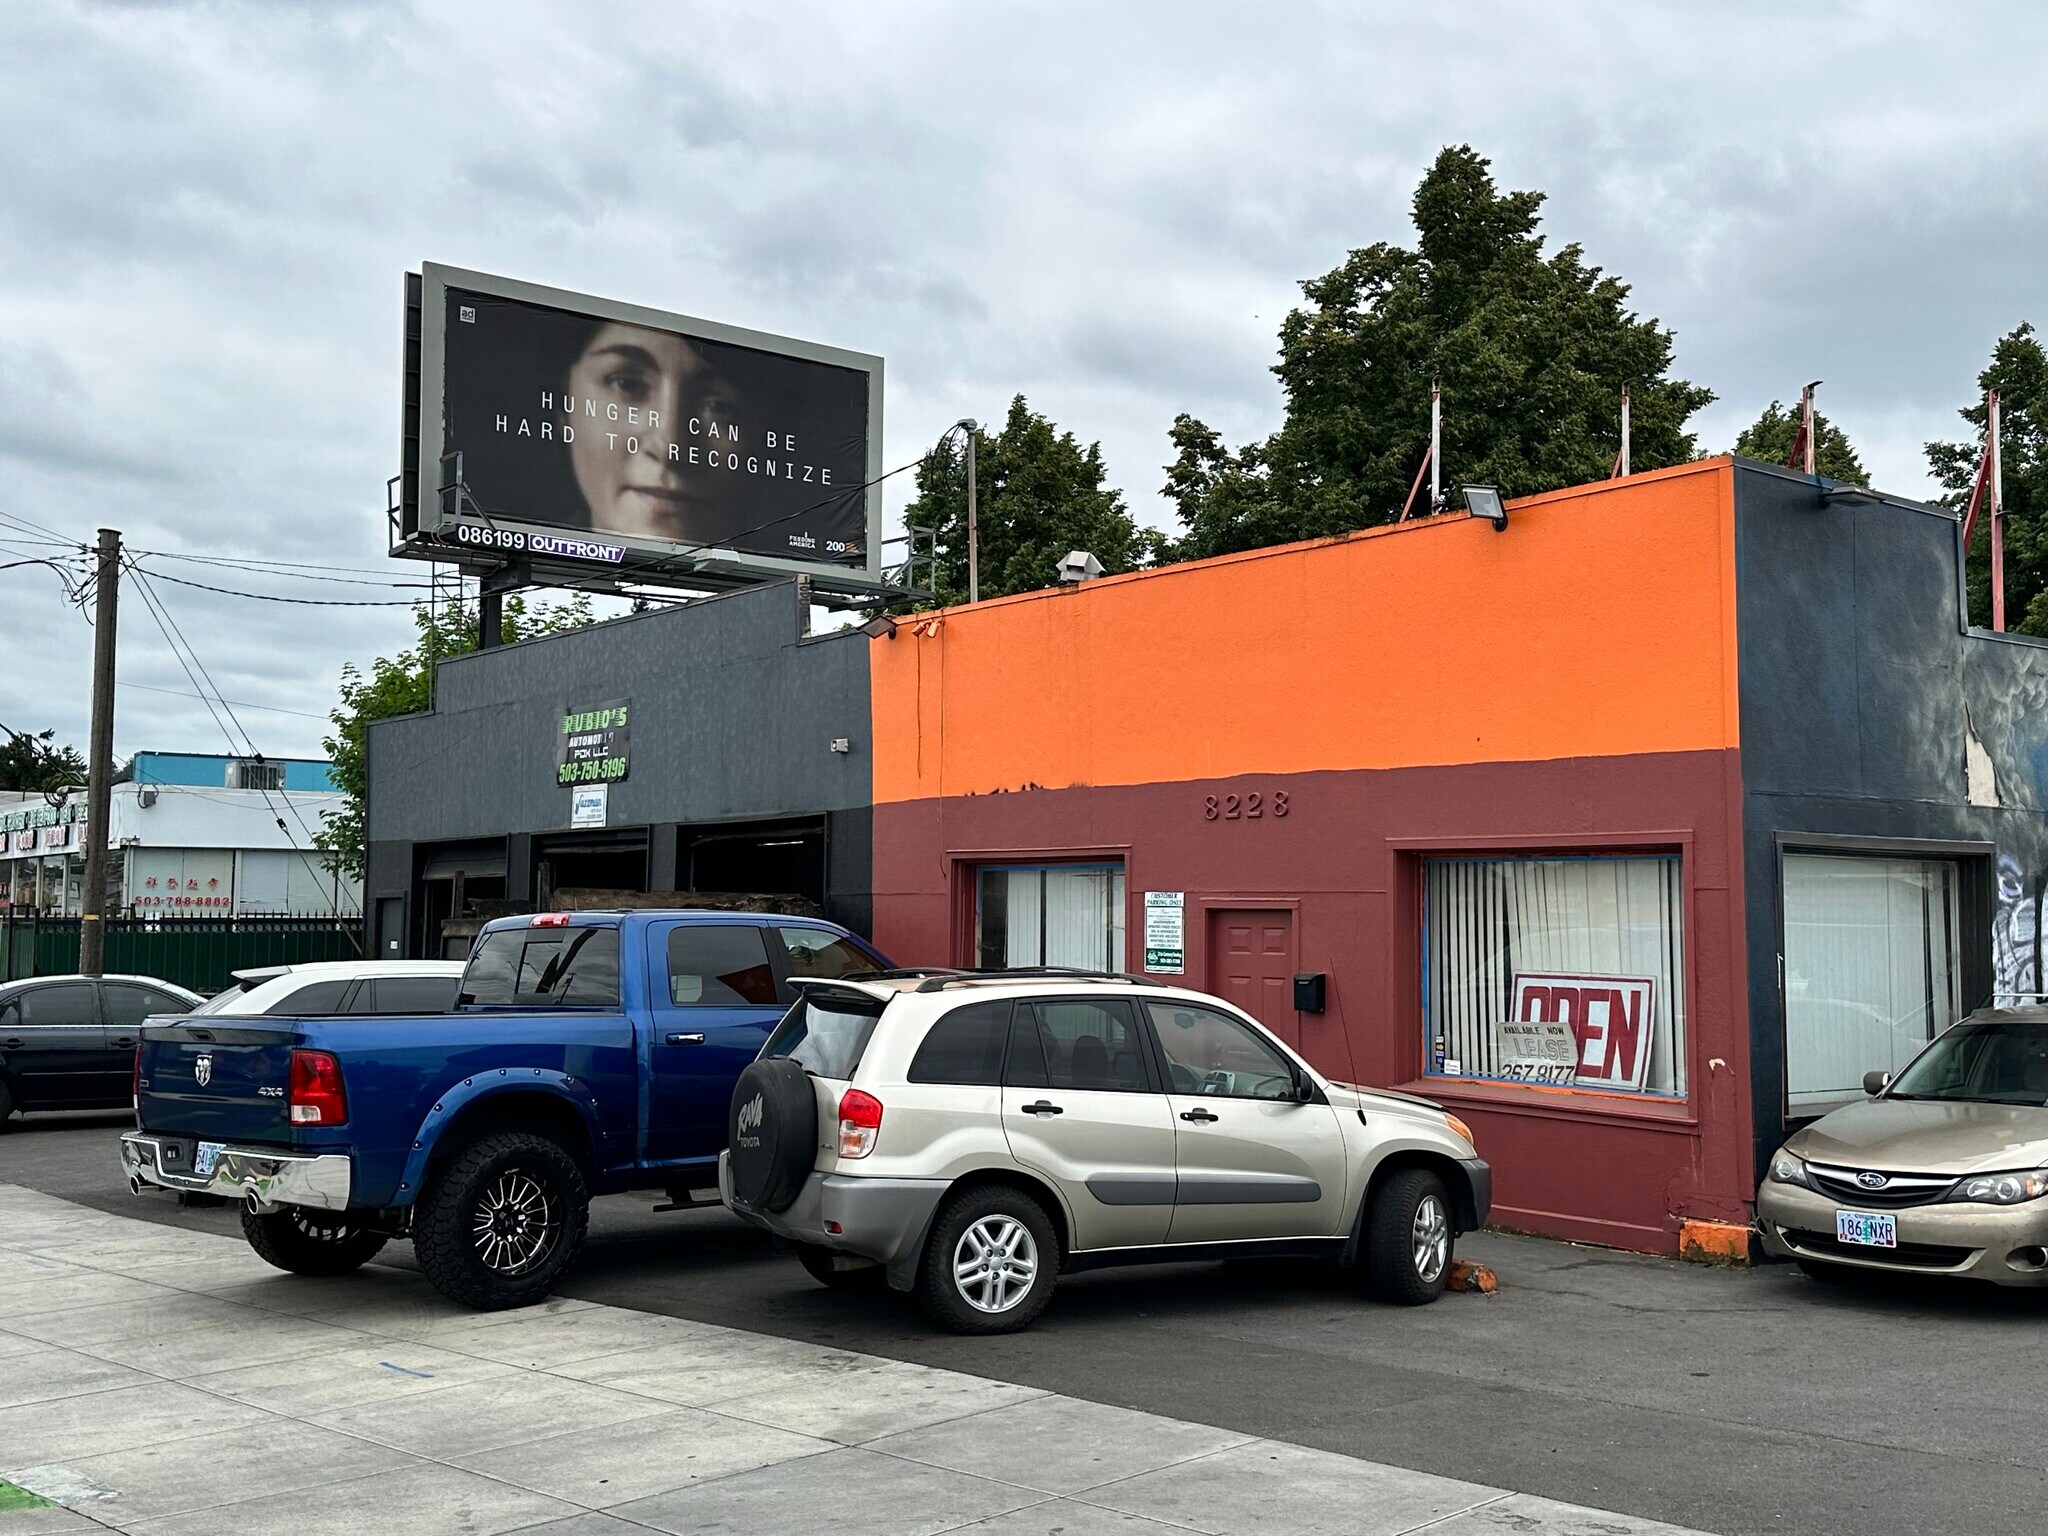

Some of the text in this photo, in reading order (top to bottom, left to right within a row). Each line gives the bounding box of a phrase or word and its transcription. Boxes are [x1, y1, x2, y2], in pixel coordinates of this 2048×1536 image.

[541, 391, 796, 451] HUNGER CAN BE
[496, 414, 832, 485] HARD TO RECOGNIZE
[457, 525, 525, 549] 086199
[531, 536, 620, 561] OUTFRONT
[561, 707, 627, 733] RUBIO'S
[592, 746, 609, 757] LLC
[559, 756, 626, 783] 503-750-5196
[1205, 790, 1289, 820] 8228
[1504, 1025, 1565, 1035] AVAILABLE NOW
[1513, 1037, 1570, 1062] LEASE
[740, 1136, 760, 1148] TOYOTA
[1840, 1218, 1893, 1241] 186 NXR
